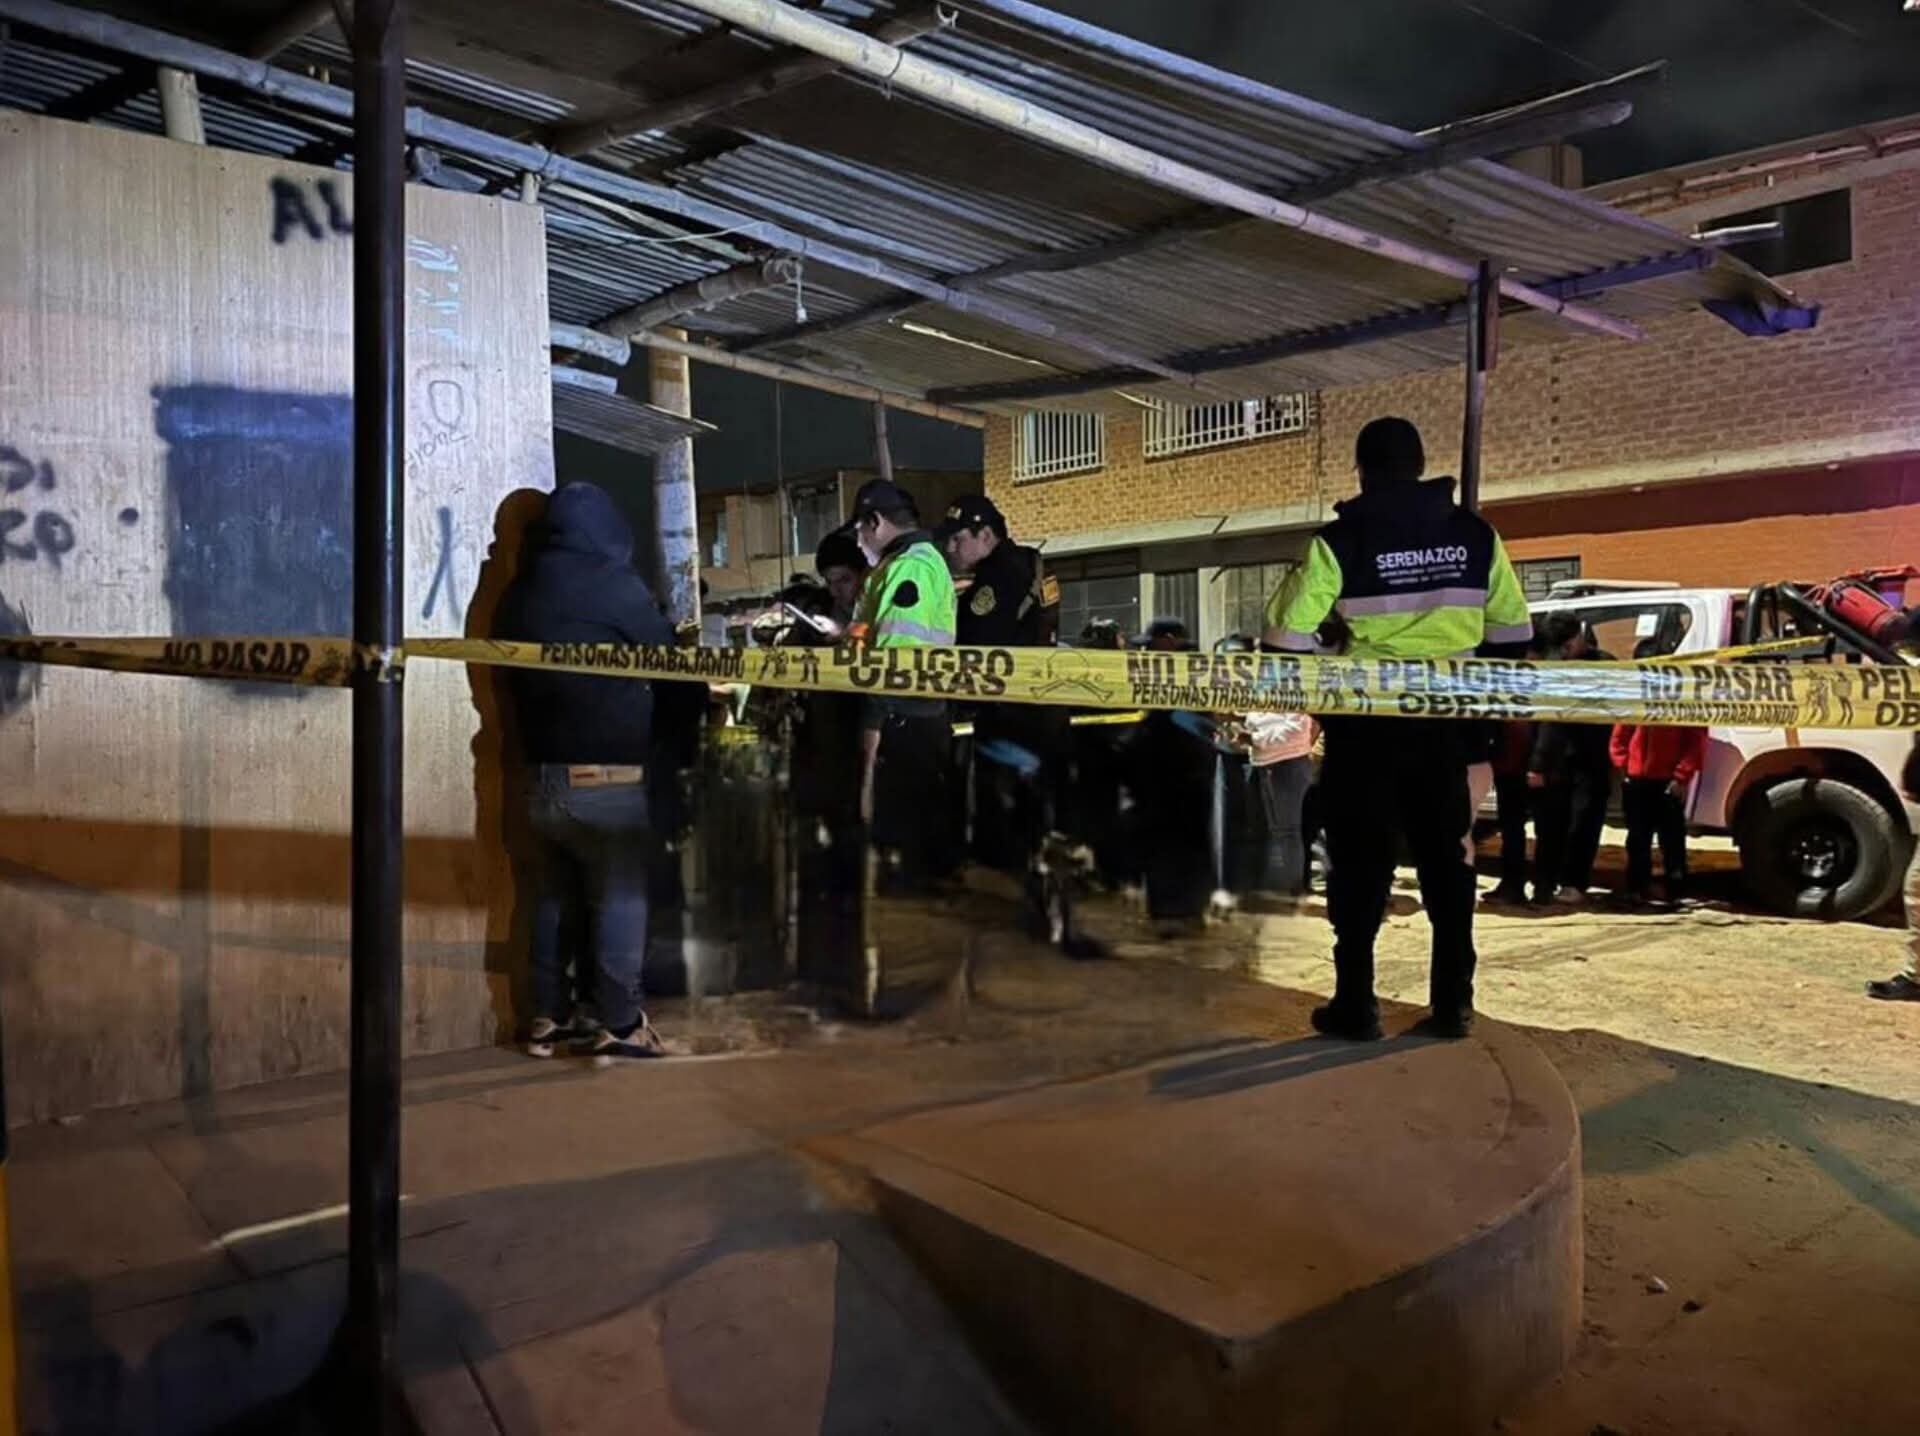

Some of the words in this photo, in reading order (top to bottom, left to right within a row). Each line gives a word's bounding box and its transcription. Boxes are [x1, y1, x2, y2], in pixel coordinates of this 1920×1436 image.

[1376, 545, 1468, 570] SERENAZGO
[1126, 652, 1175, 688] NO
[1187, 653, 1302, 691] PASAR
[1377, 658, 1541, 695] PELIGRO
[1637, 663, 1684, 701] NO
[1690, 663, 1796, 702] PASAR
[1398, 692, 1536, 719] OBRAS
